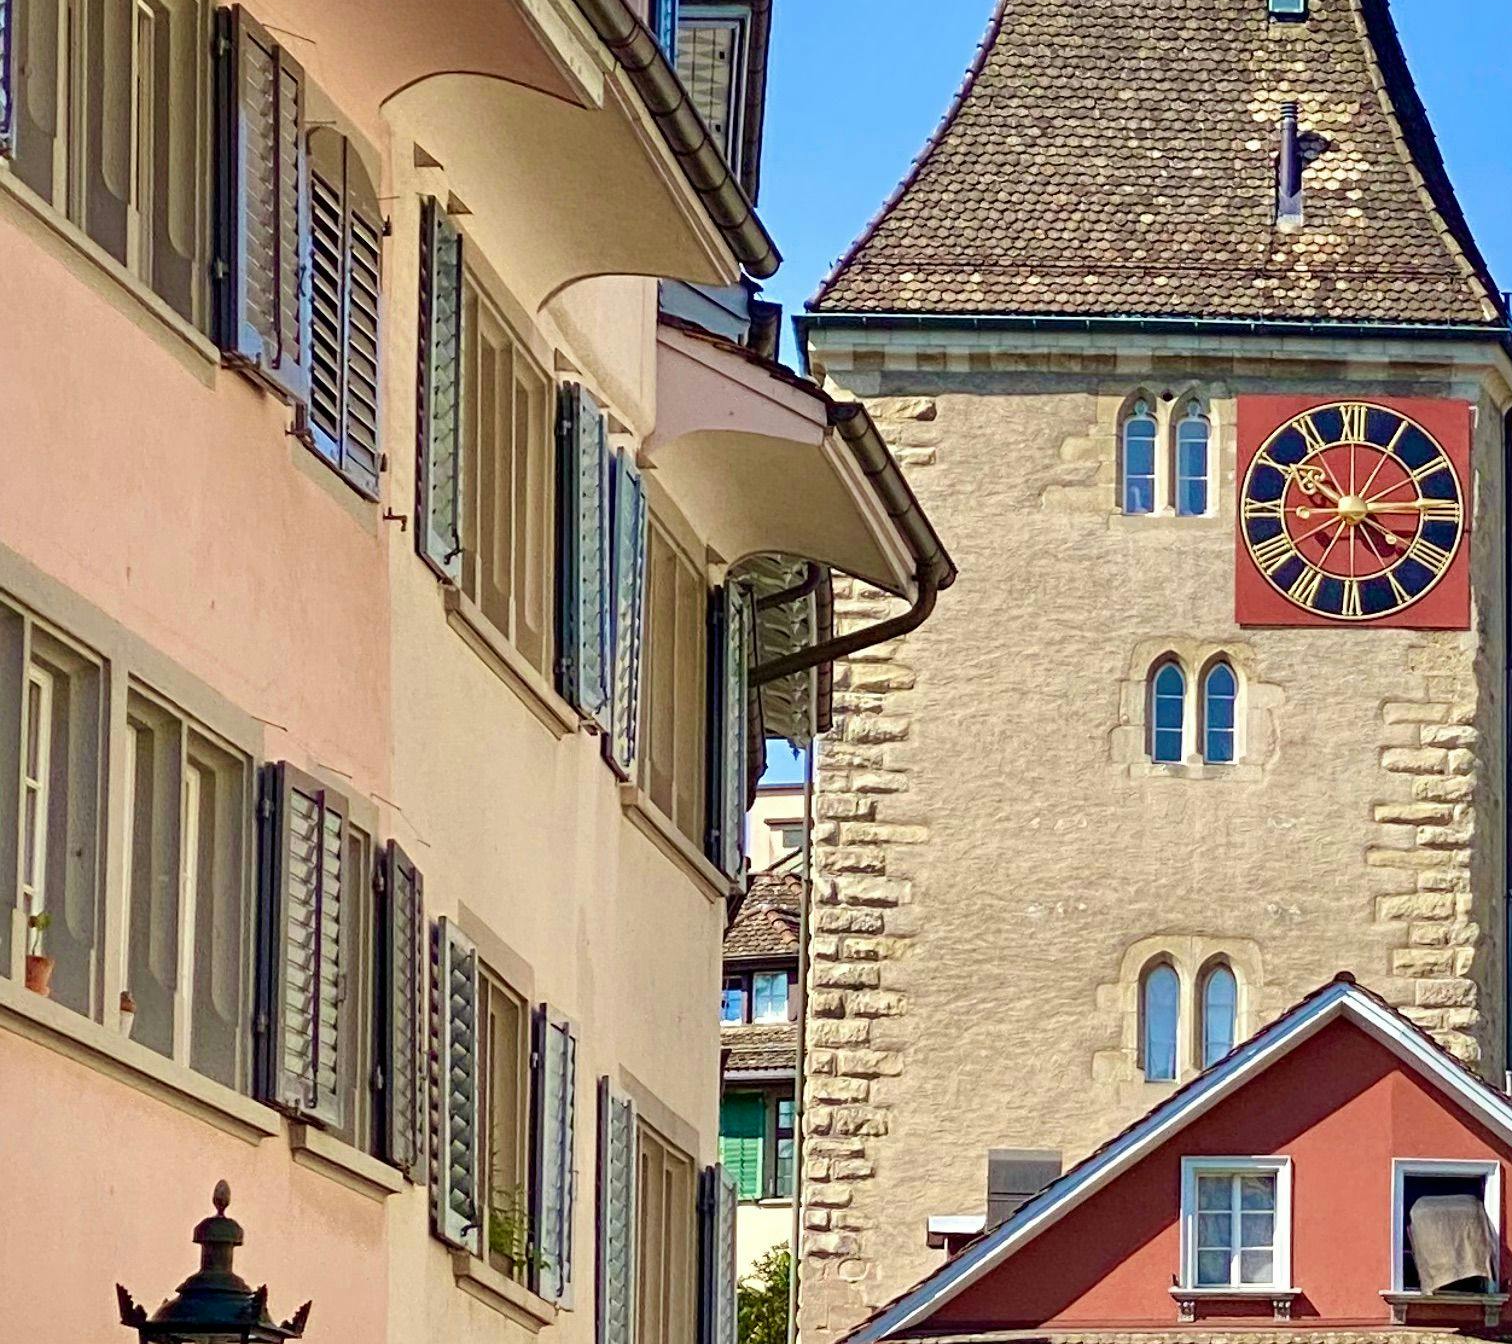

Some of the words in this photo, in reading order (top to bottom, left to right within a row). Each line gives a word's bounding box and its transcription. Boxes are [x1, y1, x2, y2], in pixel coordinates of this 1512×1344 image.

[1292, 415, 1326, 453] XI
[1340, 405, 1368, 443] XII
[1388, 421, 1409, 451] I
[1257, 451, 1293, 477] X
[1413, 456, 1448, 481] II
[1245, 497, 1281, 520] IX
[1252, 536, 1294, 576] VIII
[1409, 538, 1451, 575] IIII
[1288, 567, 1321, 608] VII
[1343, 579, 1363, 616] VI
[1387, 571, 1412, 605] V
